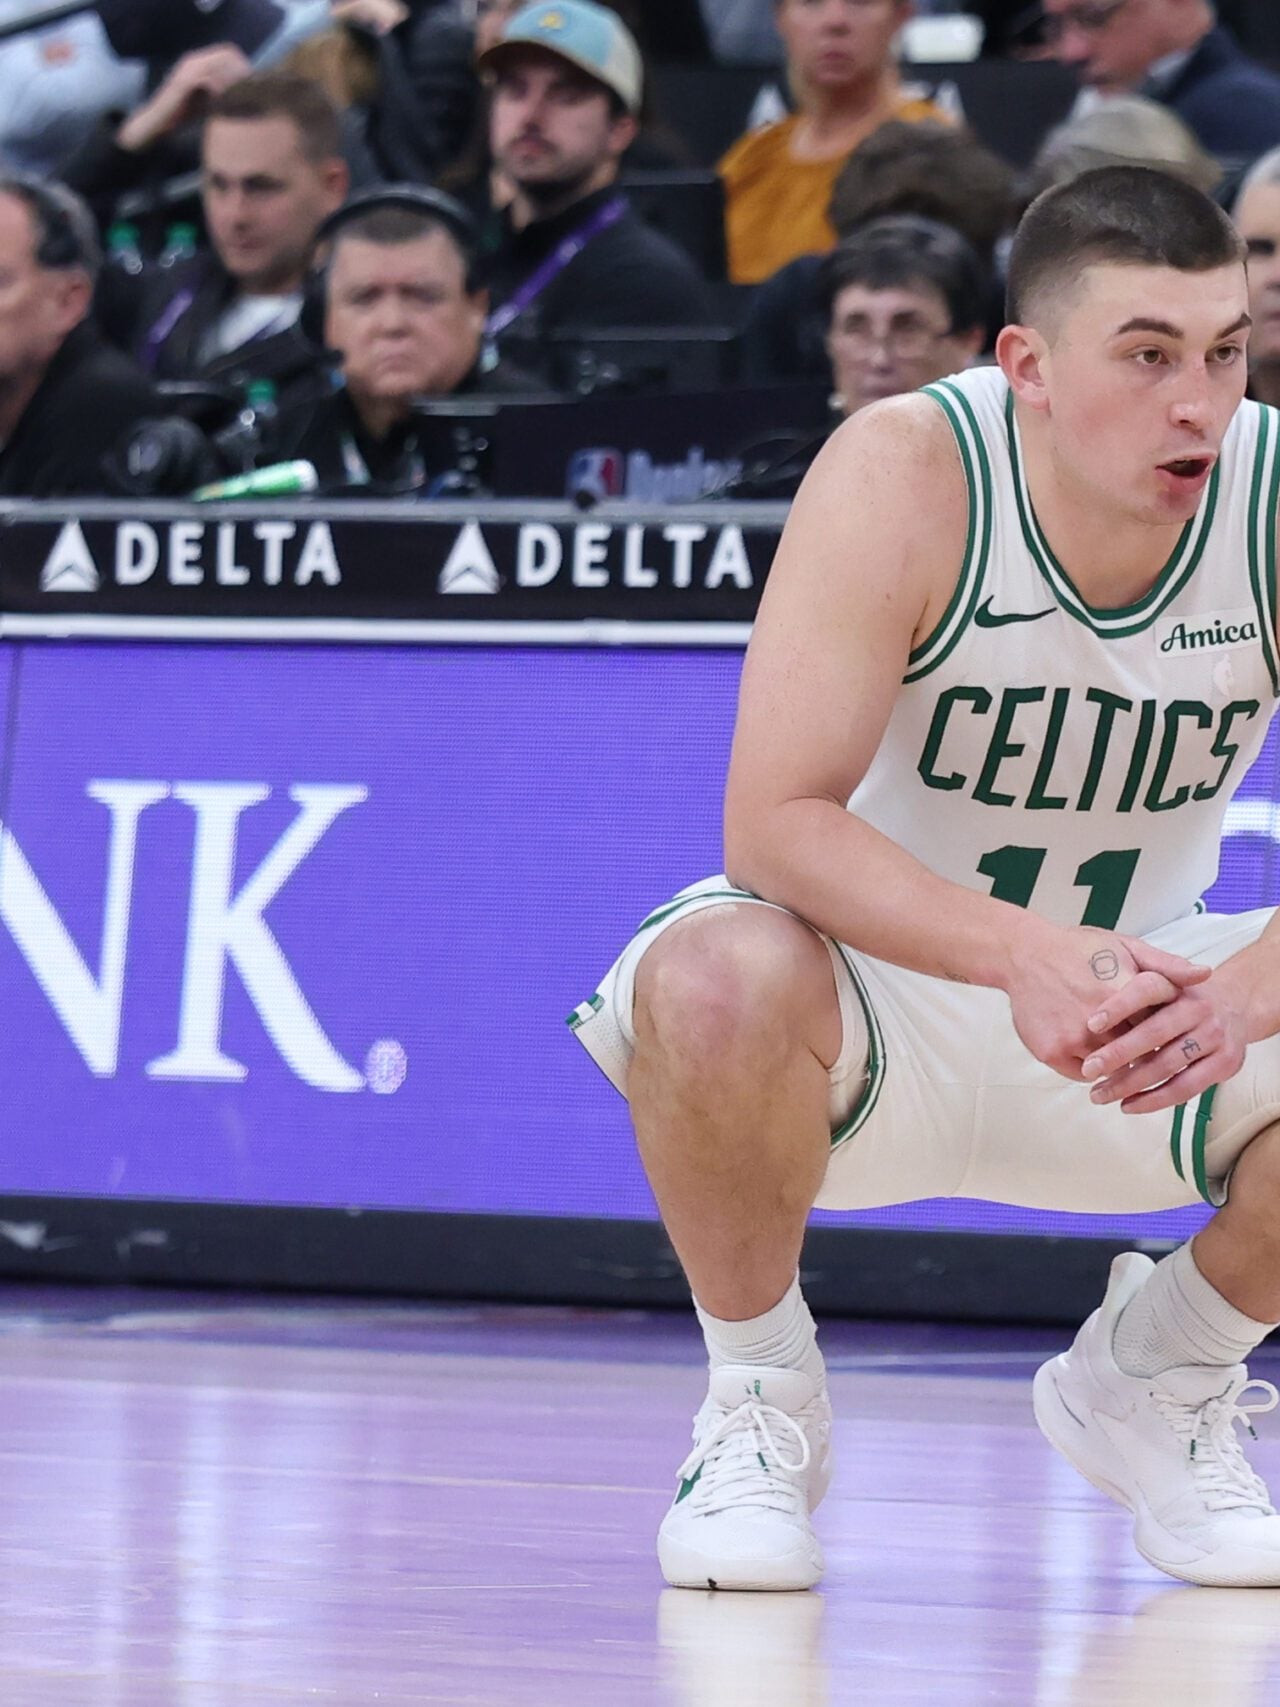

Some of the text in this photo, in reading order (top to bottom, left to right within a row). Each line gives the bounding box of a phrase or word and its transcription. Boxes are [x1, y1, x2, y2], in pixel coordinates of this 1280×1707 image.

[116, 522, 340, 586] DELTA
[517, 524, 752, 588] DELTA
[1160, 619, 1258, 652] Amica
[917, 686, 1260, 812] CELTICS
